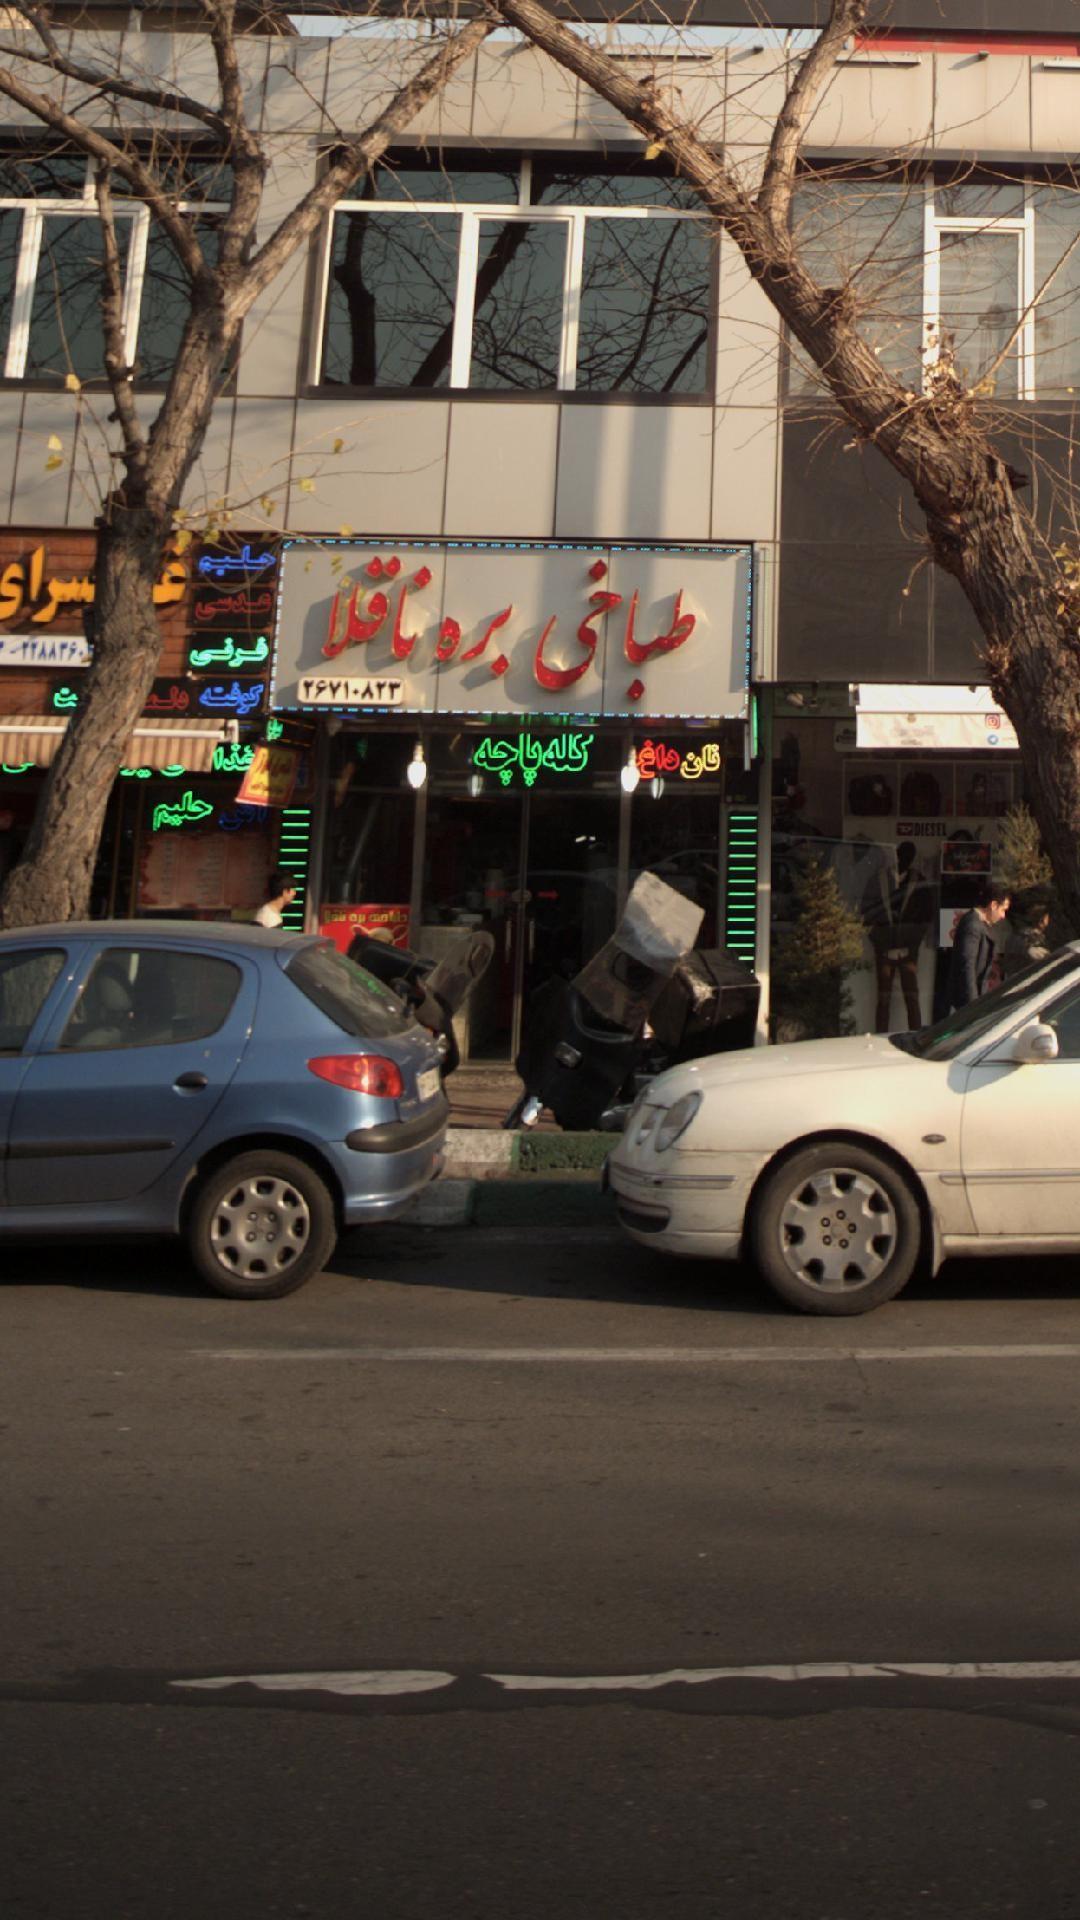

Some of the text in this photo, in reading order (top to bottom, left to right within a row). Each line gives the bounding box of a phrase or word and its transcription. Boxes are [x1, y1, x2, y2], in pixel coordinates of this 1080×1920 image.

[195, 592, 271, 619] عدسی
[322, 556, 698, 701] طباخی بره ناقلا
[190, 636, 269, 667] فرنی
[199, 681, 265, 714] کوفته
[472, 733, 543, 787] پاچه
[637, 739, 720, 779] نان داغ
[914, 823, 947, 837] DIESEL
